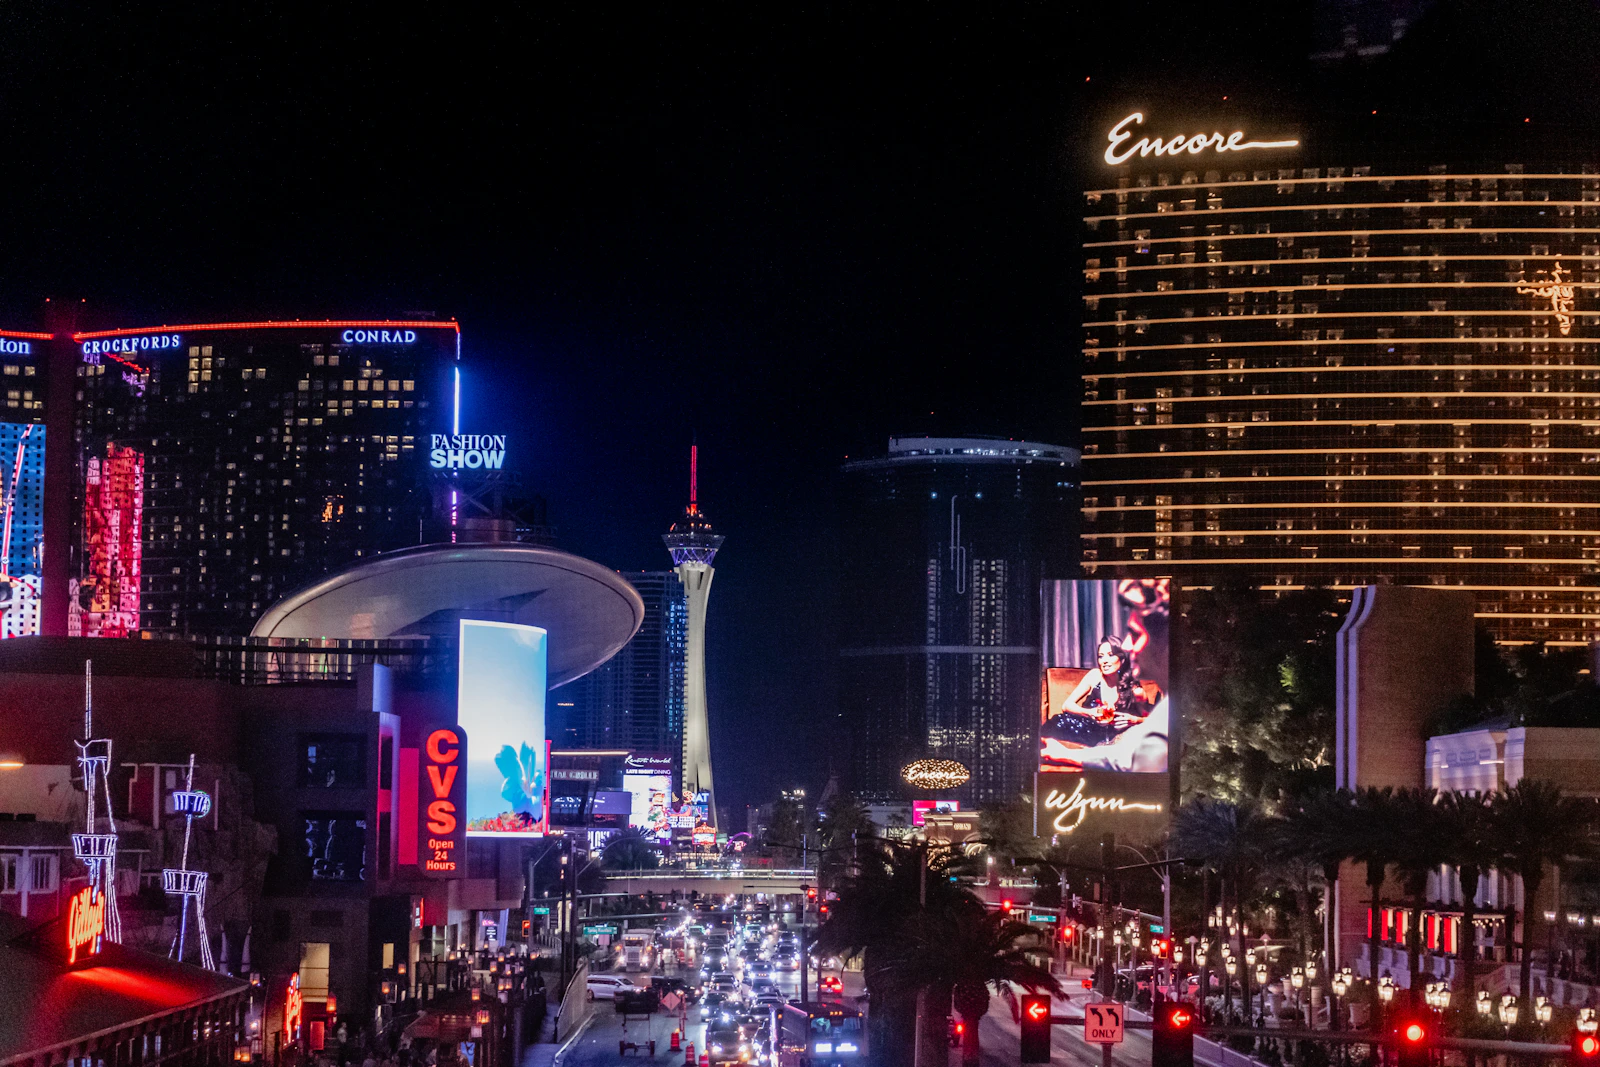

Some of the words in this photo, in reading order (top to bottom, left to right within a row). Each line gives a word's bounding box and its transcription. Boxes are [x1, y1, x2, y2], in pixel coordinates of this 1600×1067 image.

[1104, 112, 1299, 165] Encore
[82, 334, 180, 354] CROCKFORDS
[342, 330, 416, 343] CONRAD
[430, 434, 507, 450] FASHION
[429, 450, 506, 469] SHOW
[906, 763, 970, 781] Encore
[426, 729, 460, 835] CVS
[1044, 777, 1163, 832] Wynn
[428, 838, 454, 850] Open
[434, 851, 448, 860] 24
[426, 861, 456, 871] Hours
[1092, 1029, 1116, 1038] ONLY
